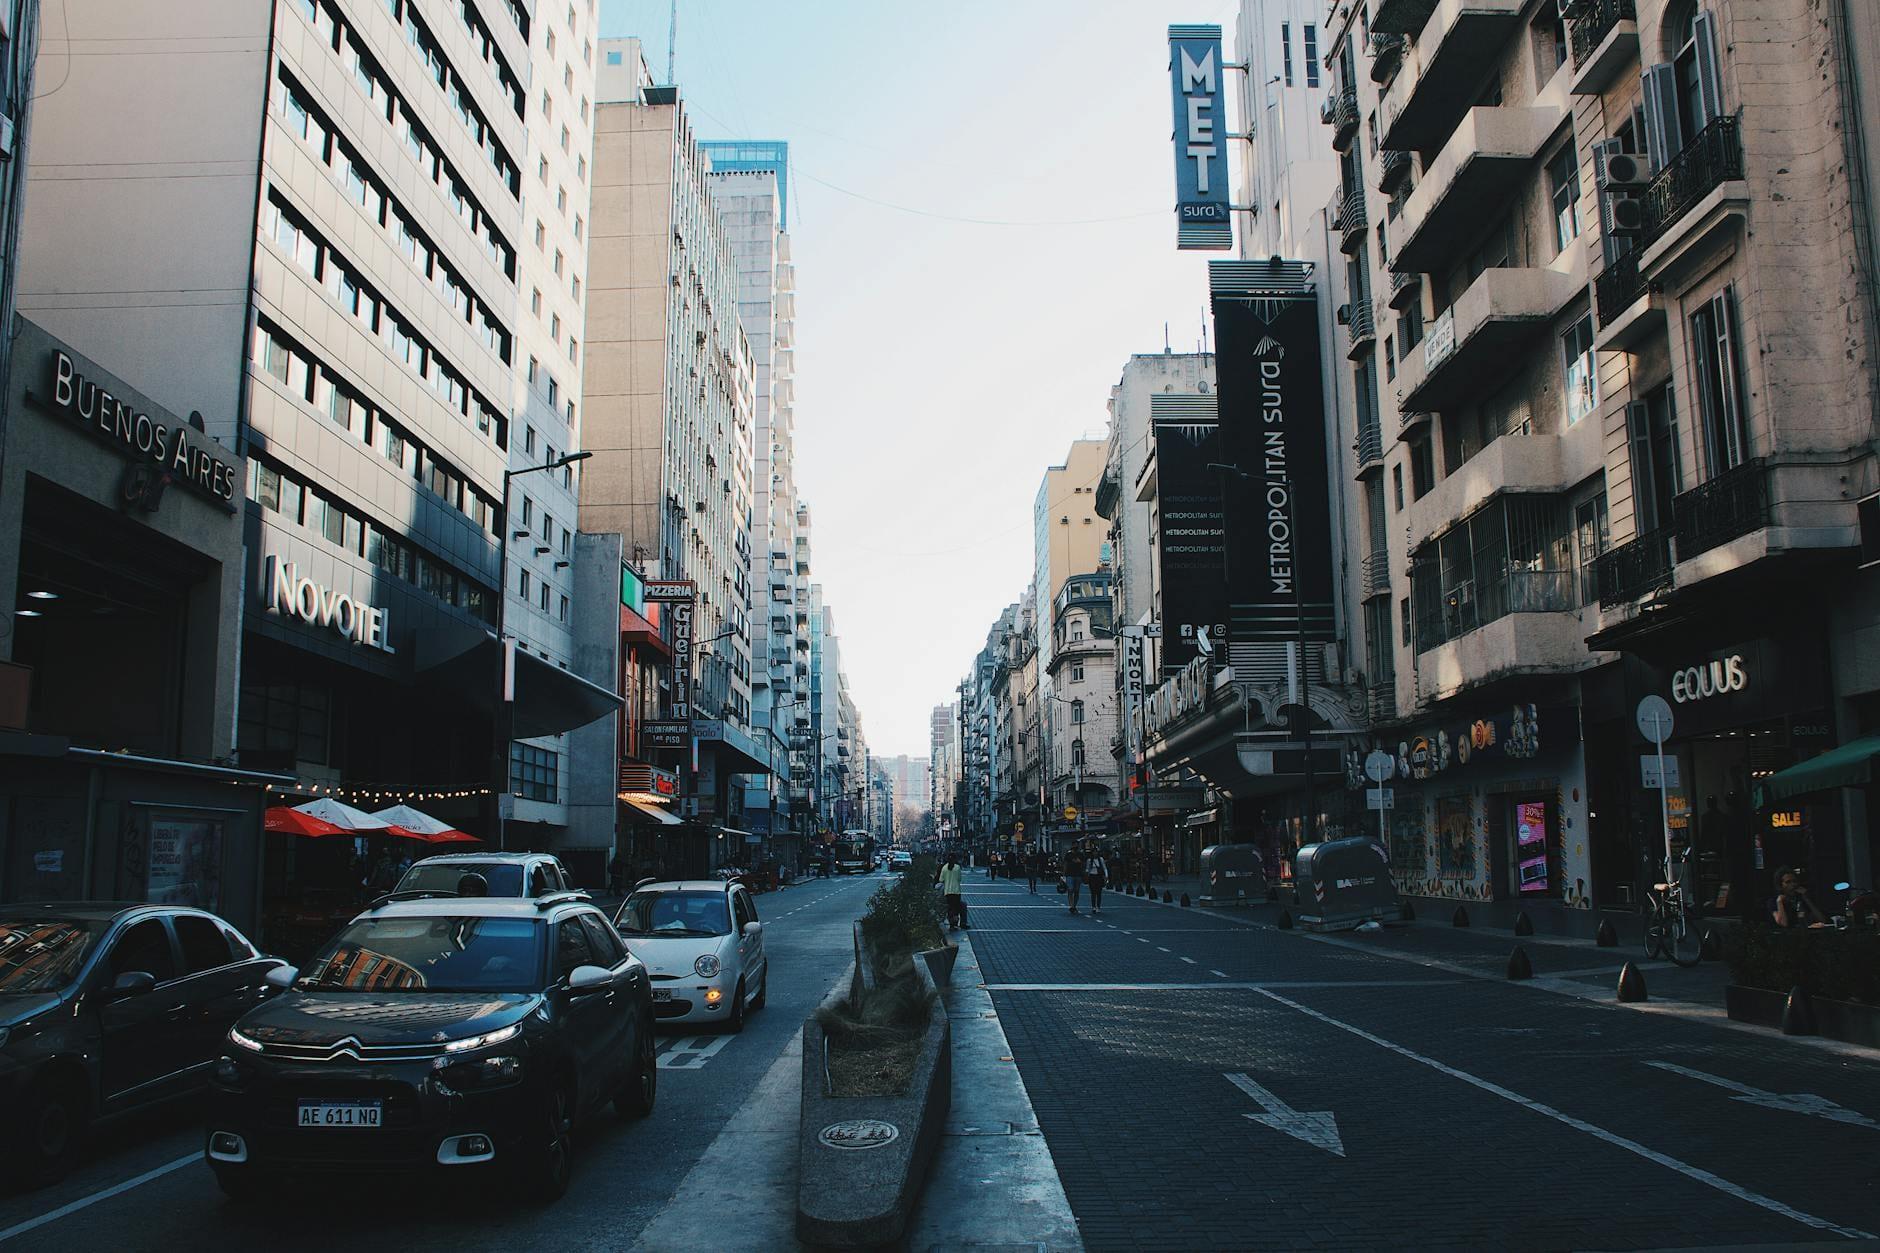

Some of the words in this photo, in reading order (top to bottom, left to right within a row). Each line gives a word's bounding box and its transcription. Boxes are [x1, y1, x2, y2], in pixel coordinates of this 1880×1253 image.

[1180, 44, 1217, 194] MET
[1183, 204, 1215, 217] sura
[54, 350, 168, 463] BUENOS
[173, 430, 235, 501] AIRES
[1263, 430, 1292, 594] METROPOLITAN
[1165, 528, 1208, 536] METROPOLITAN
[1165, 545, 1208, 553] METROPOLITAN
[645, 585, 692, 597] PIZZERIA
[267, 554, 396, 655] NOVOTEL
[673, 604, 692, 718] Guerrin
[1672, 653, 1748, 703] EQUUS
[665, 735, 680, 744] PISO
[1772, 812, 1801, 828] SALE
[302, 1108, 320, 1124] AE
[326, 1108, 353, 1124] 611
[359, 1108, 377, 1124] NQ
